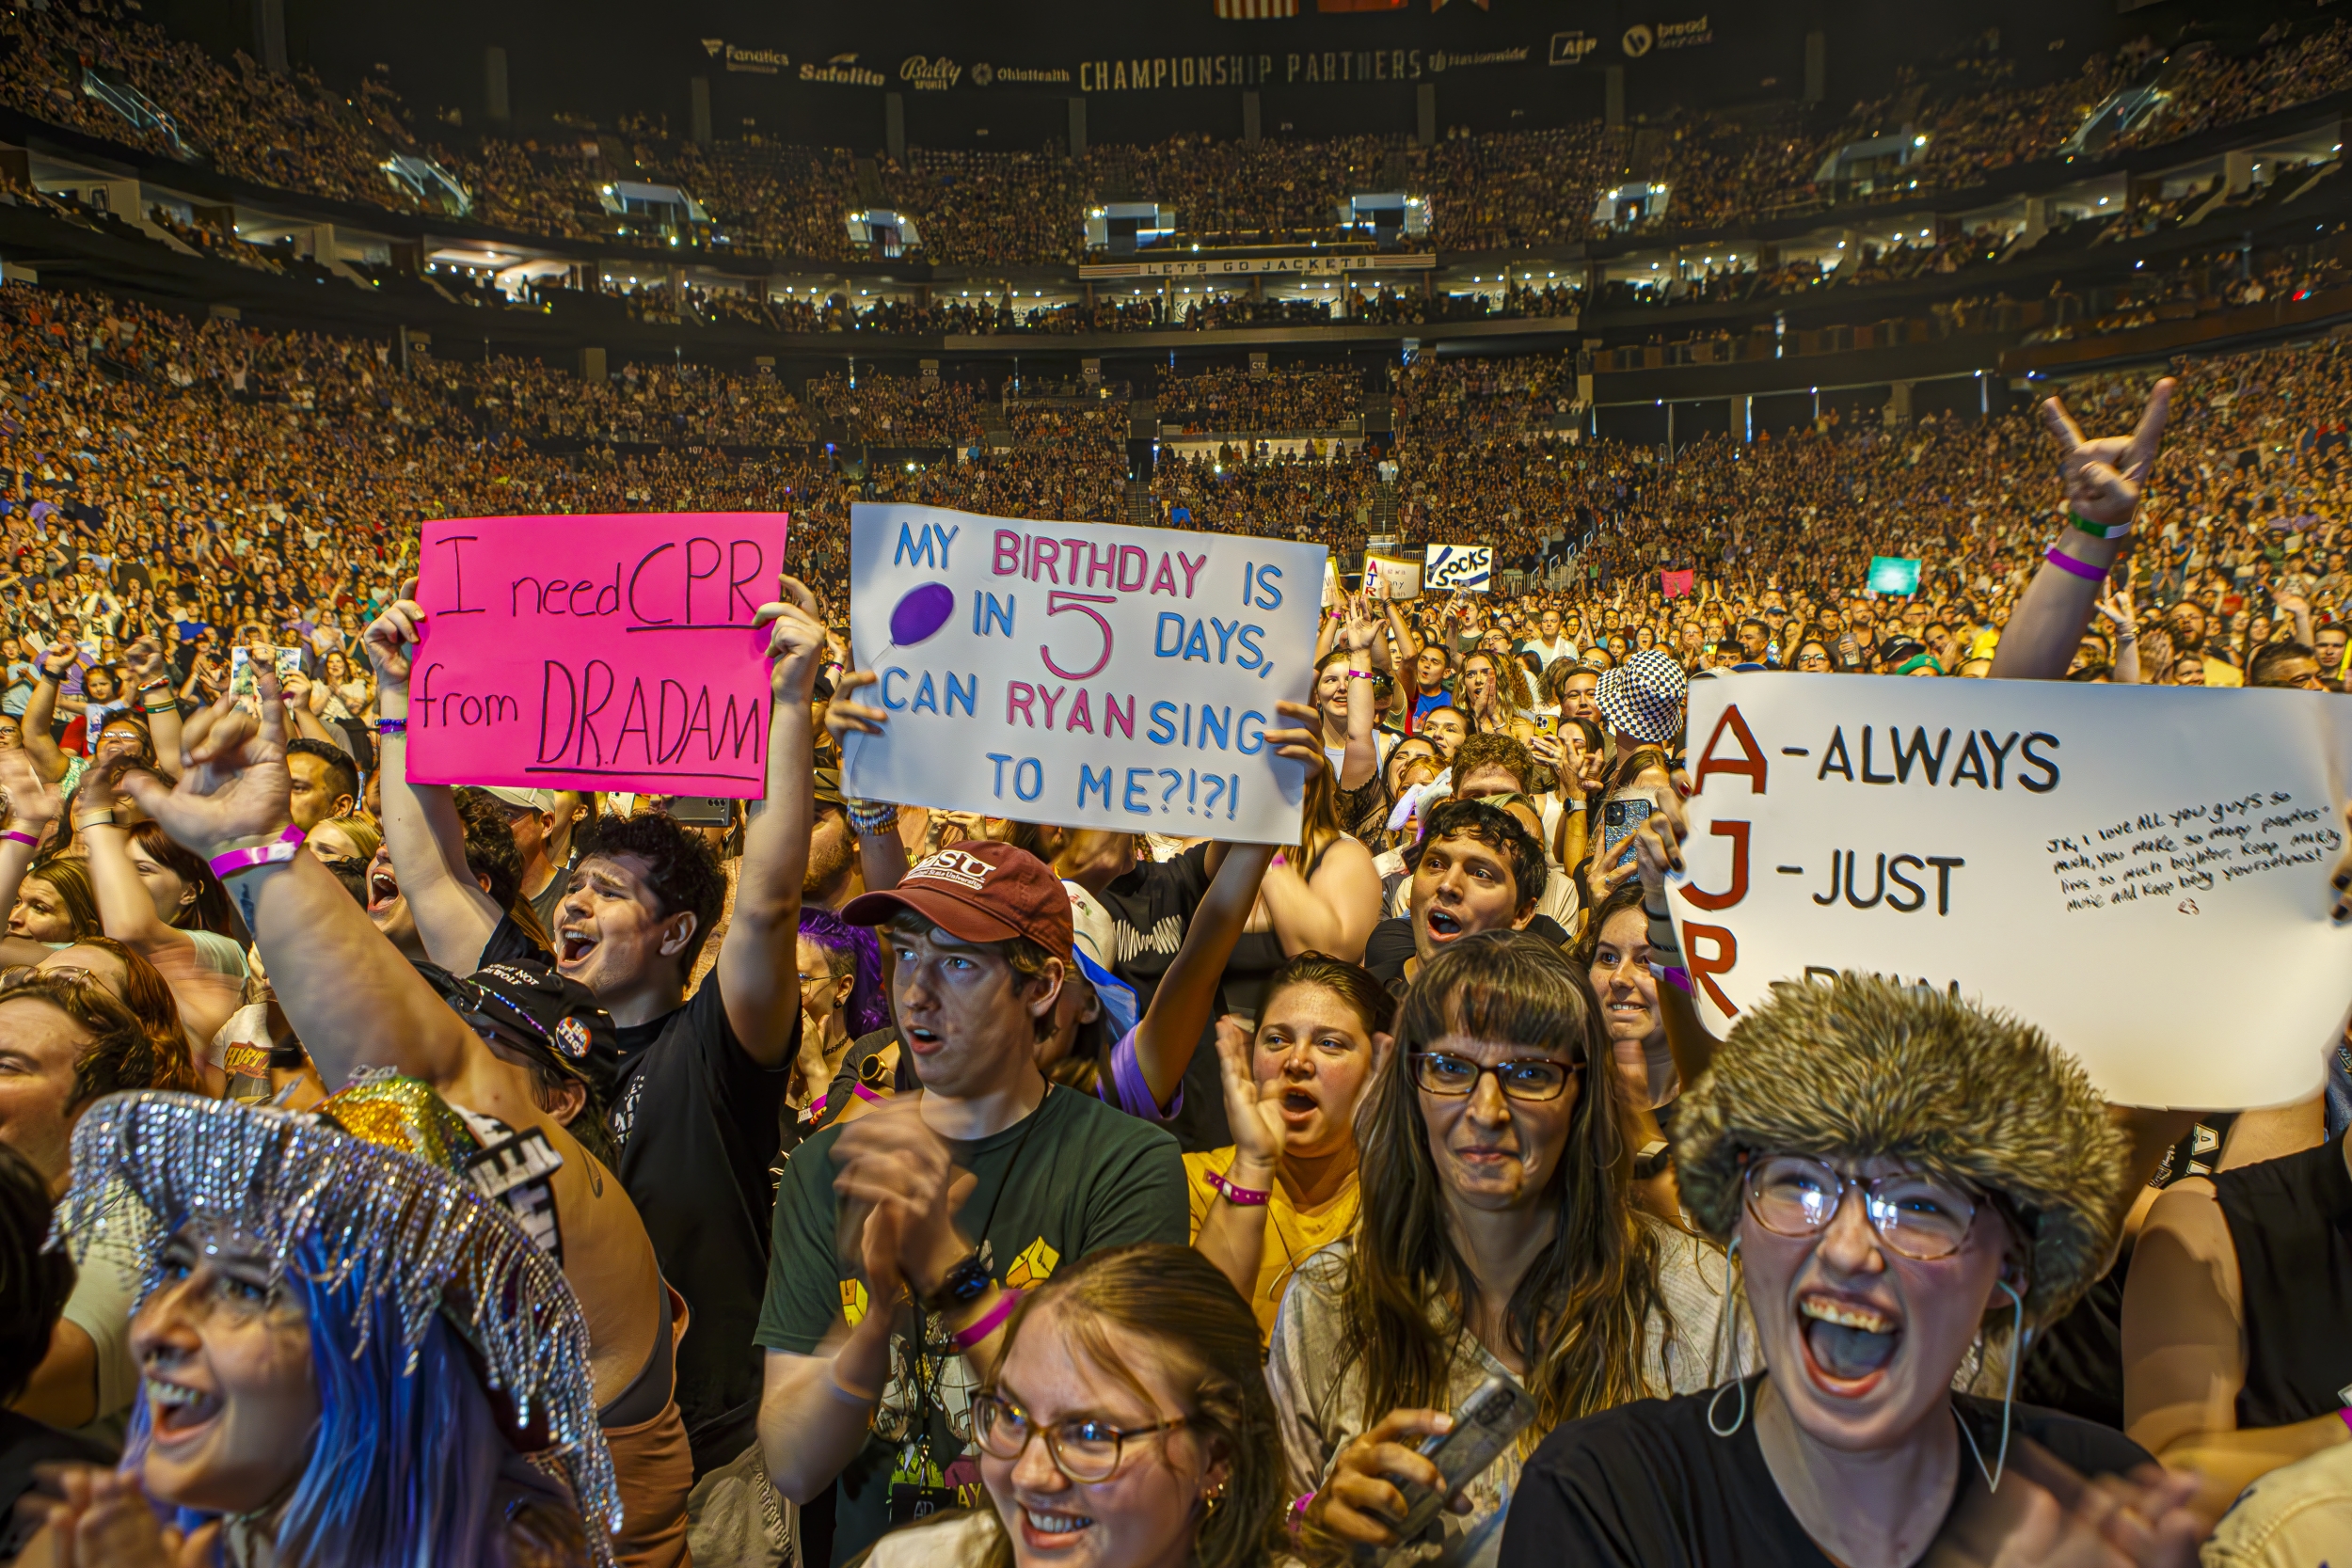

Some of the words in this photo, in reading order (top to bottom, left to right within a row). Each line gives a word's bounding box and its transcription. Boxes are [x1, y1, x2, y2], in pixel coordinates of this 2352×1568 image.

[1657, 14, 1708, 39] bread
[725, 43, 788, 67] Fanatics
[899, 55, 961, 87] Bally
[1080, 55, 1272, 92] CHAMPIONSHIP
[1287, 49, 1422, 83] PARTNERS
[799, 63, 885, 87] Safelite
[996, 68, 1071, 83] OhioHealth
[1147, 262, 1207, 274] LET'S
[1223, 261, 1249, 272] GO
[1262, 258, 1367, 271] JACKETS
[436, 536, 486, 617] I
[511, 562, 622, 617] need
[628, 537, 764, 625] CPR
[894, 521, 960, 572] MY
[992, 528, 1207, 599] BIRTHDAY
[1242, 561, 1283, 610] IS
[1436, 547, 1489, 587] SOCKS
[972, 589, 1016, 638] IN
[1040, 589, 1118, 682] 5
[1153, 610, 1275, 679] DAYS,
[414, 662, 519, 728] from
[882, 665, 979, 718] CAN
[1006, 679, 1136, 740] RYAN
[1147, 699, 1267, 755] SING
[1817, 723, 2061, 794] ALWAYS
[985, 752, 1044, 802] TO
[1077, 762, 1240, 822] ME?!?!
[2097, 820, 2134, 842] love
[2168, 804, 2207, 829] you
[2207, 792, 2264, 825] guys
[2269, 790, 2293, 806] so
[2095, 850, 2125, 869] you
[2183, 833, 2204, 847] so
[1812, 847, 1966, 917] JUST
[2097, 875, 2116, 887] so
[2122, 859, 2162, 882] much
[2110, 882, 2138, 905] and
[515, 969, 540, 986] NOT
[559, 1022, 586, 1055] They
[571, 1022, 587, 1043] He
